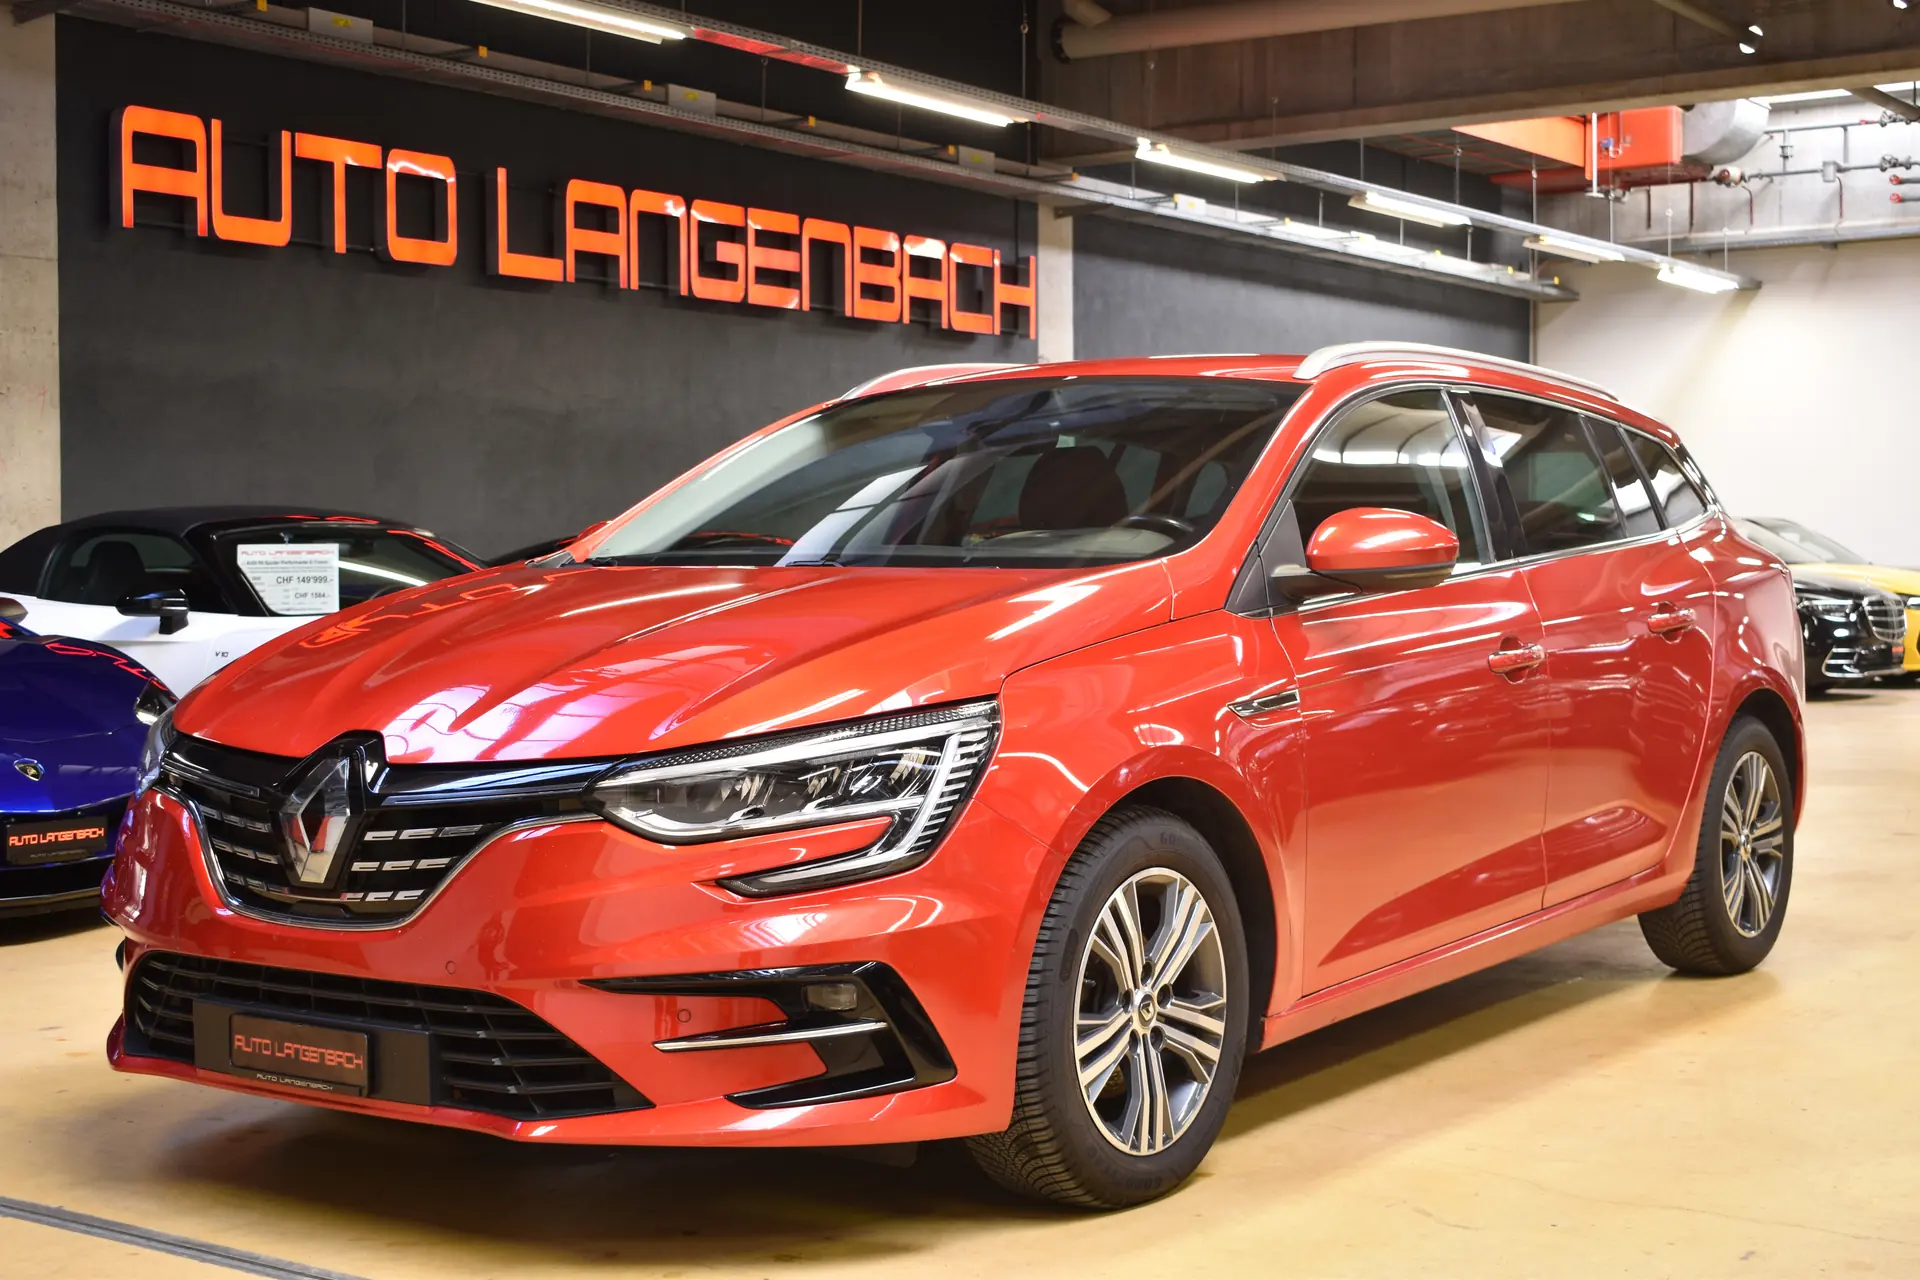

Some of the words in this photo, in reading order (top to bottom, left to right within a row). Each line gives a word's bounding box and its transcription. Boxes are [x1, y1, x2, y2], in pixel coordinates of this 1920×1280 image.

[122, 105, 457, 266] AUTO
[497, 167, 1036, 340] LANGENBACH
[276, 576, 294, 584] CHF
[9, 835, 38, 847] AUTO
[40, 827, 105, 844] LANGENBACH
[233, 1034, 271, 1055] AUTO
[275, 1041, 364, 1071] LANGENBACH
[256, 1073, 277, 1082] AUTO
[280, 1078, 333, 1090] LANGENBACH
